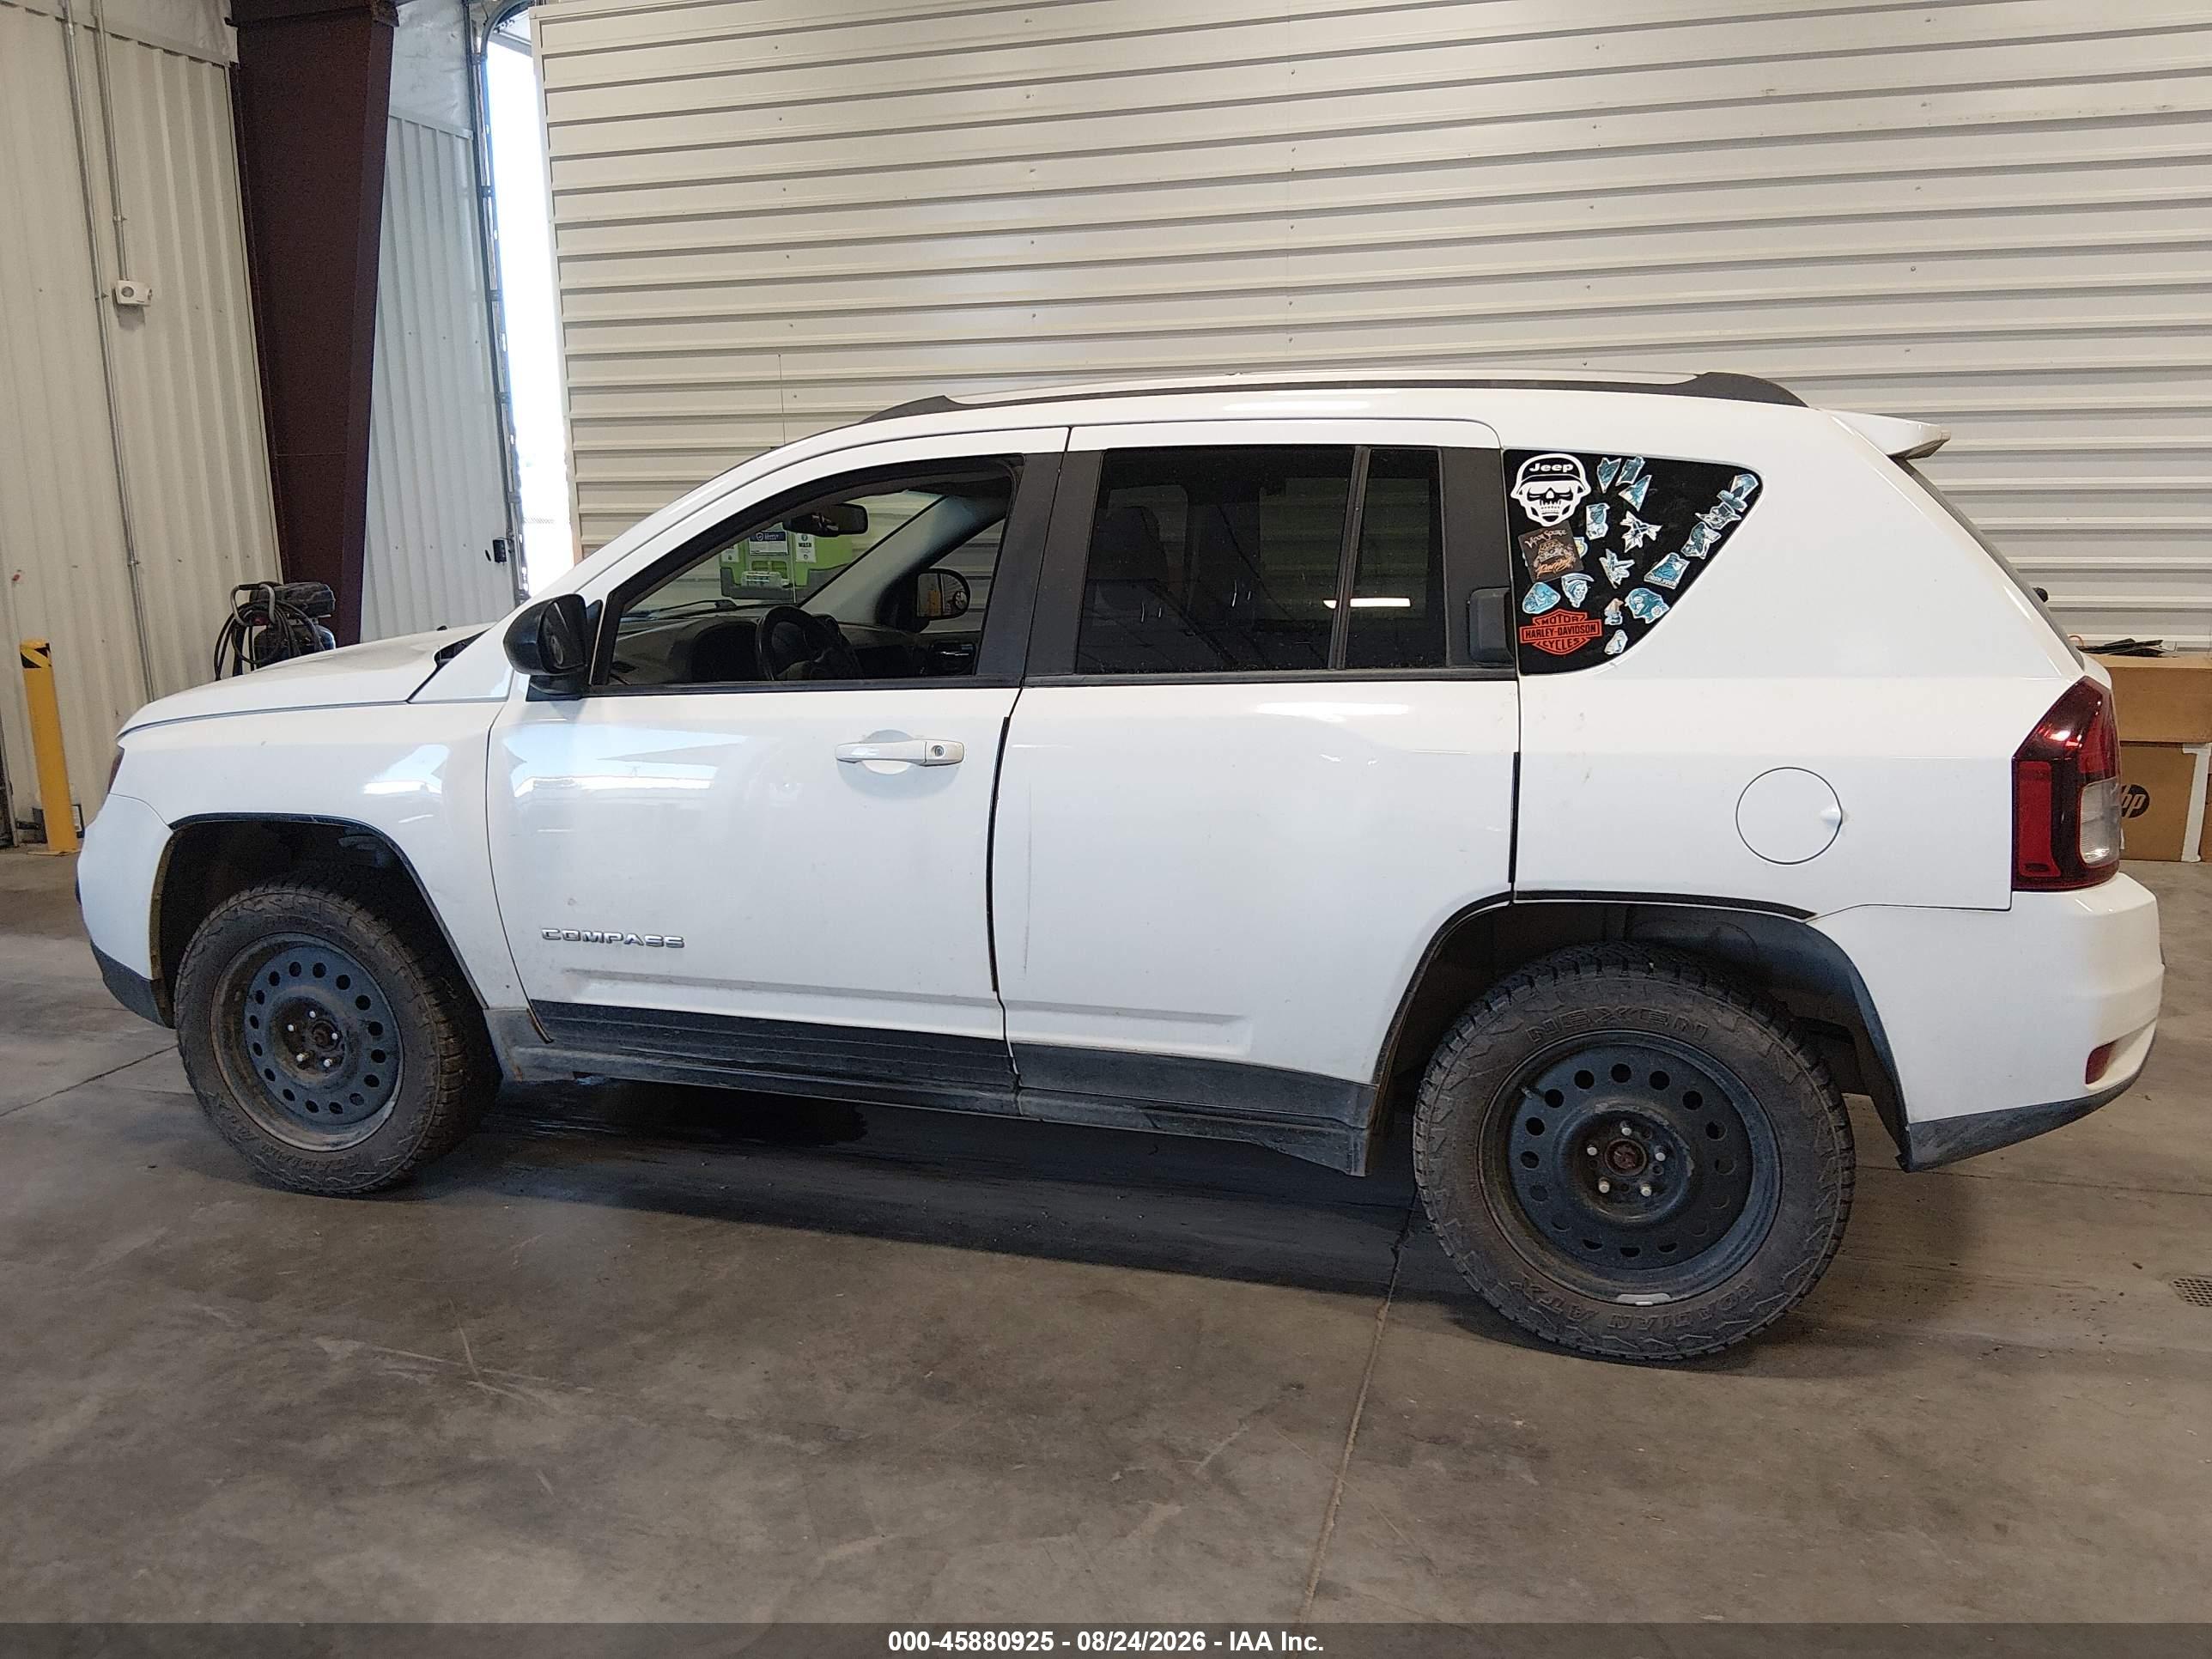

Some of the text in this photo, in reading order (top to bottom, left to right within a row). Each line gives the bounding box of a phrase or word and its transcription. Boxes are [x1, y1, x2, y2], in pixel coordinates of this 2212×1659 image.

[1528, 462, 1574, 473] Jeep
[1540, 614, 1579, 625] MOTOR
[1525, 623, 1596, 640] HARLEY-DAVIDSON
[1542, 637, 1581, 651] CYCLES
[2121, 783, 2147, 817] hp
[541, 928, 685, 949] COMPASS
[1526, 1006, 1709, 1043] NEXEN
